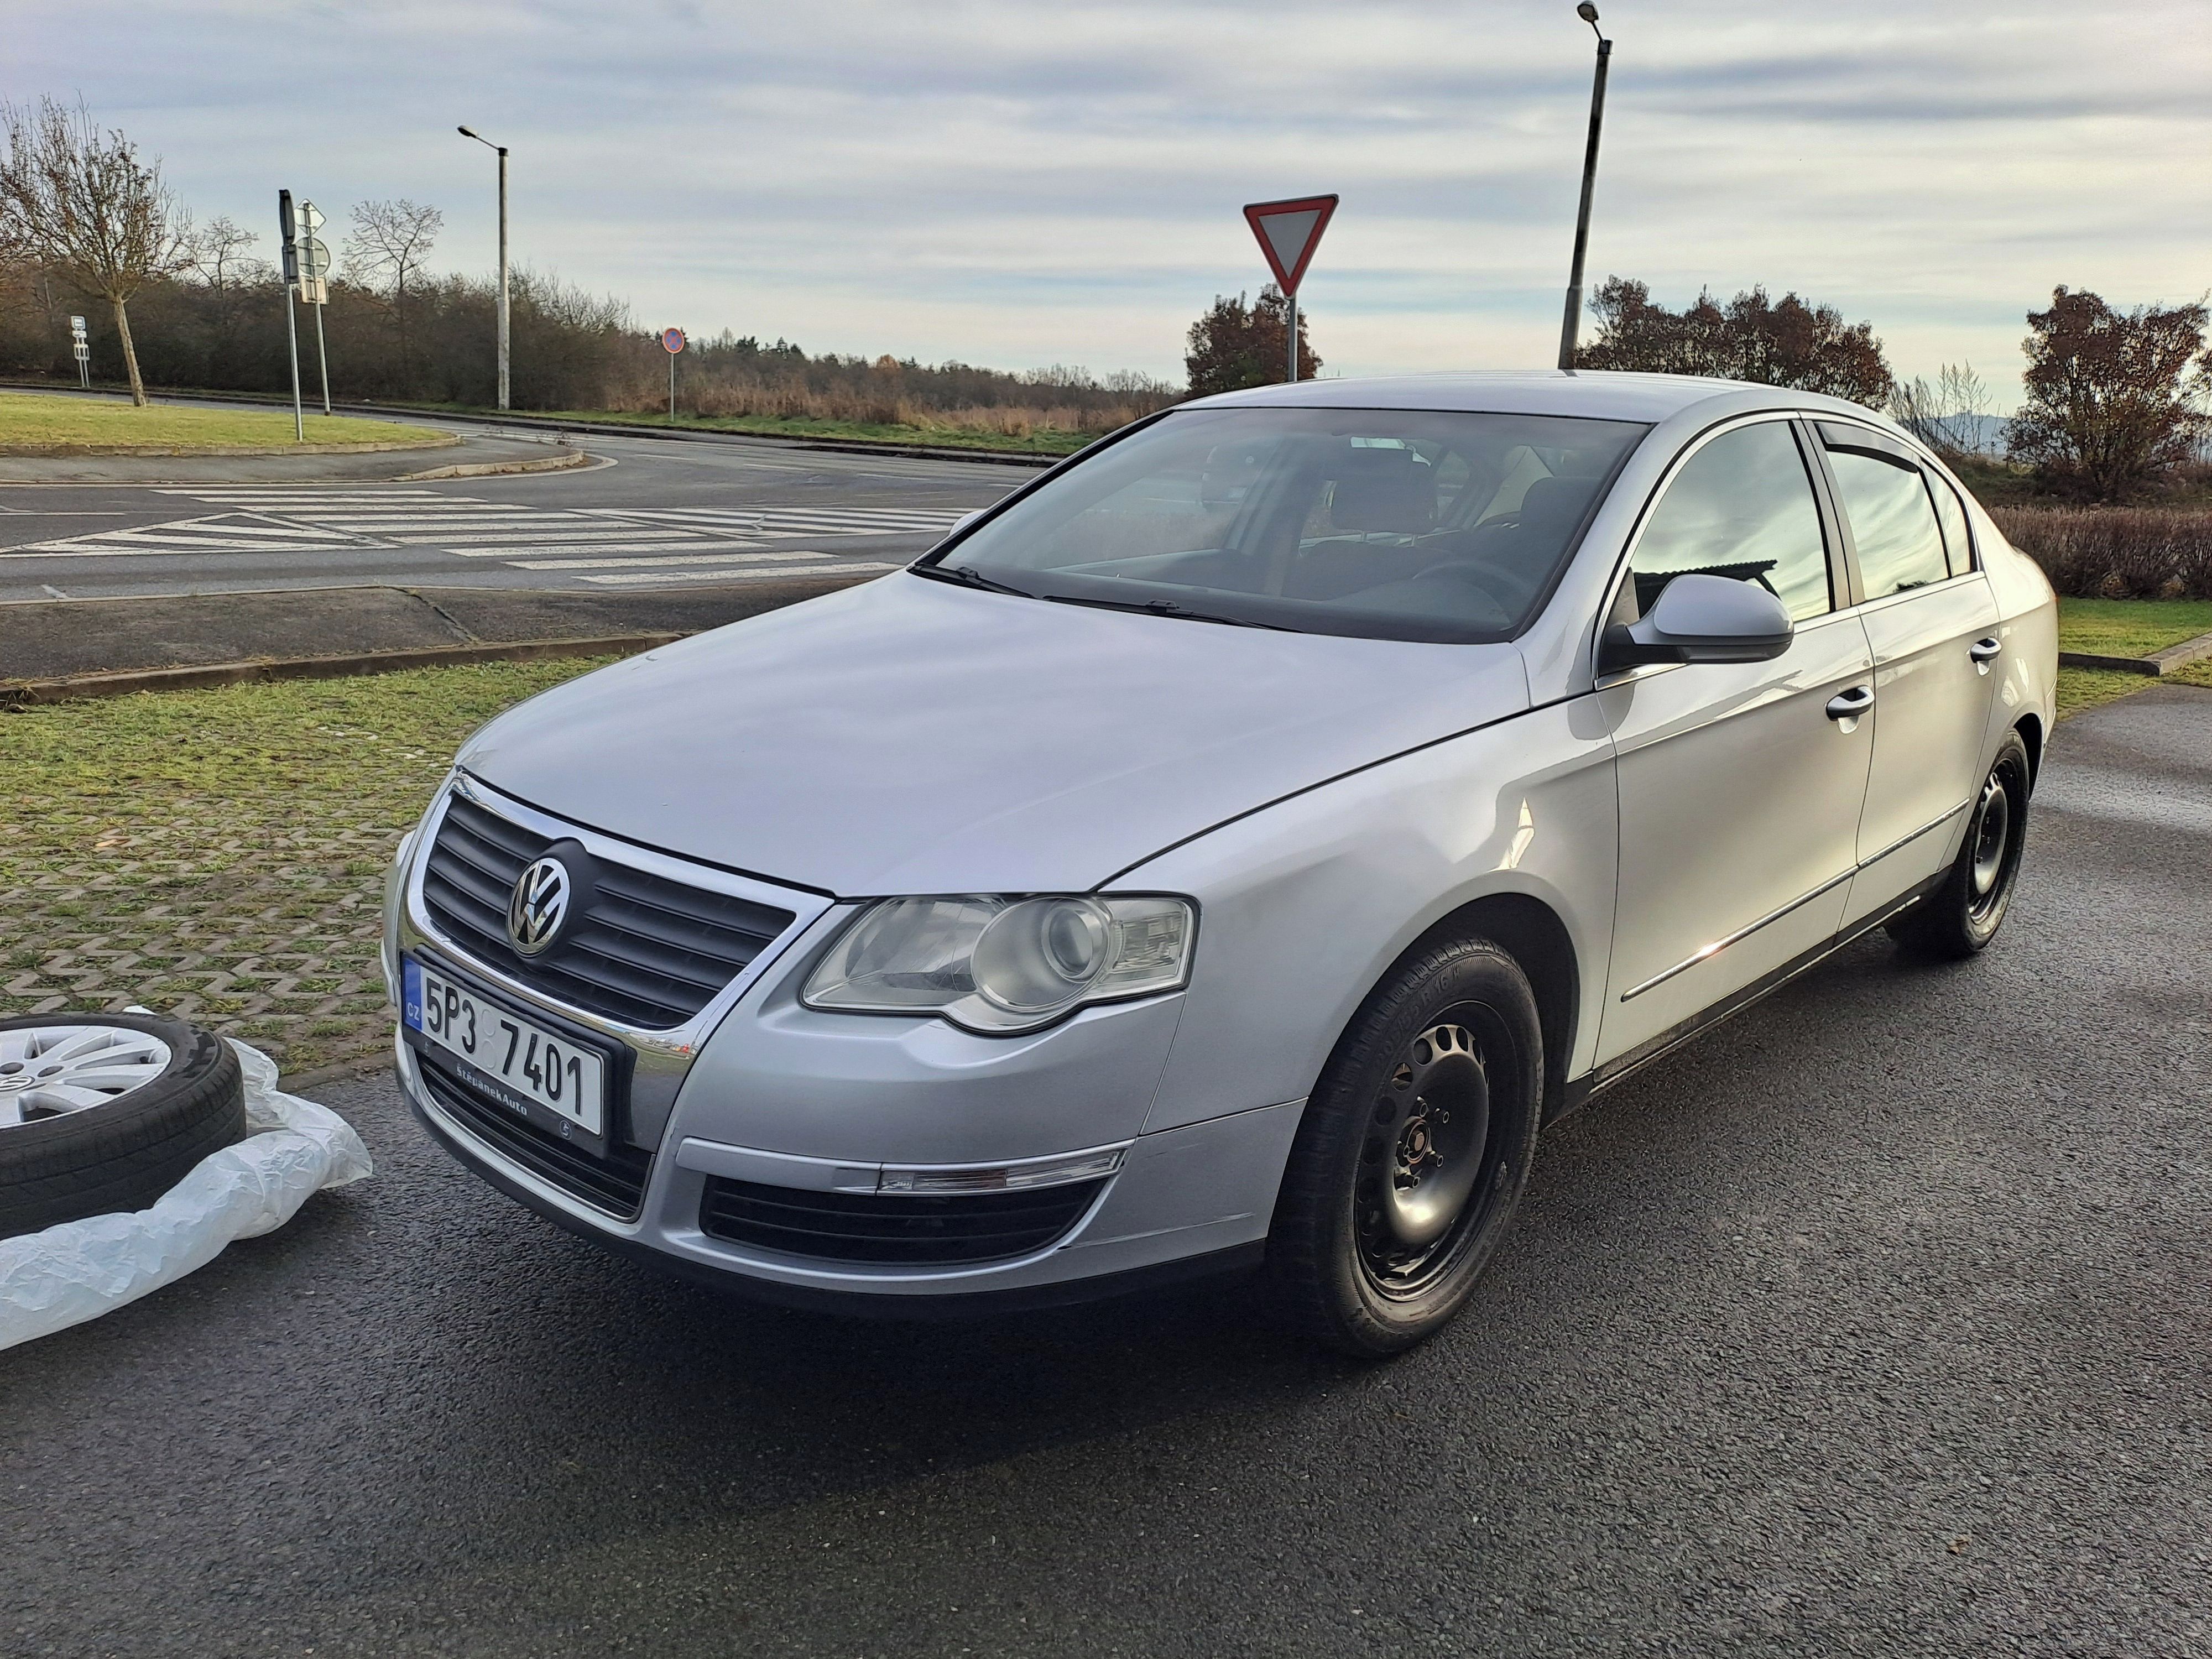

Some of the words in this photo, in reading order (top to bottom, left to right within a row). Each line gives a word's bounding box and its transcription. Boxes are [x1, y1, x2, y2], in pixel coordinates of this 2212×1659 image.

[406, 1001, 420, 1021] CZ
[426, 977, 476, 1054] 5P3
[500, 1019, 581, 1116] 7401
